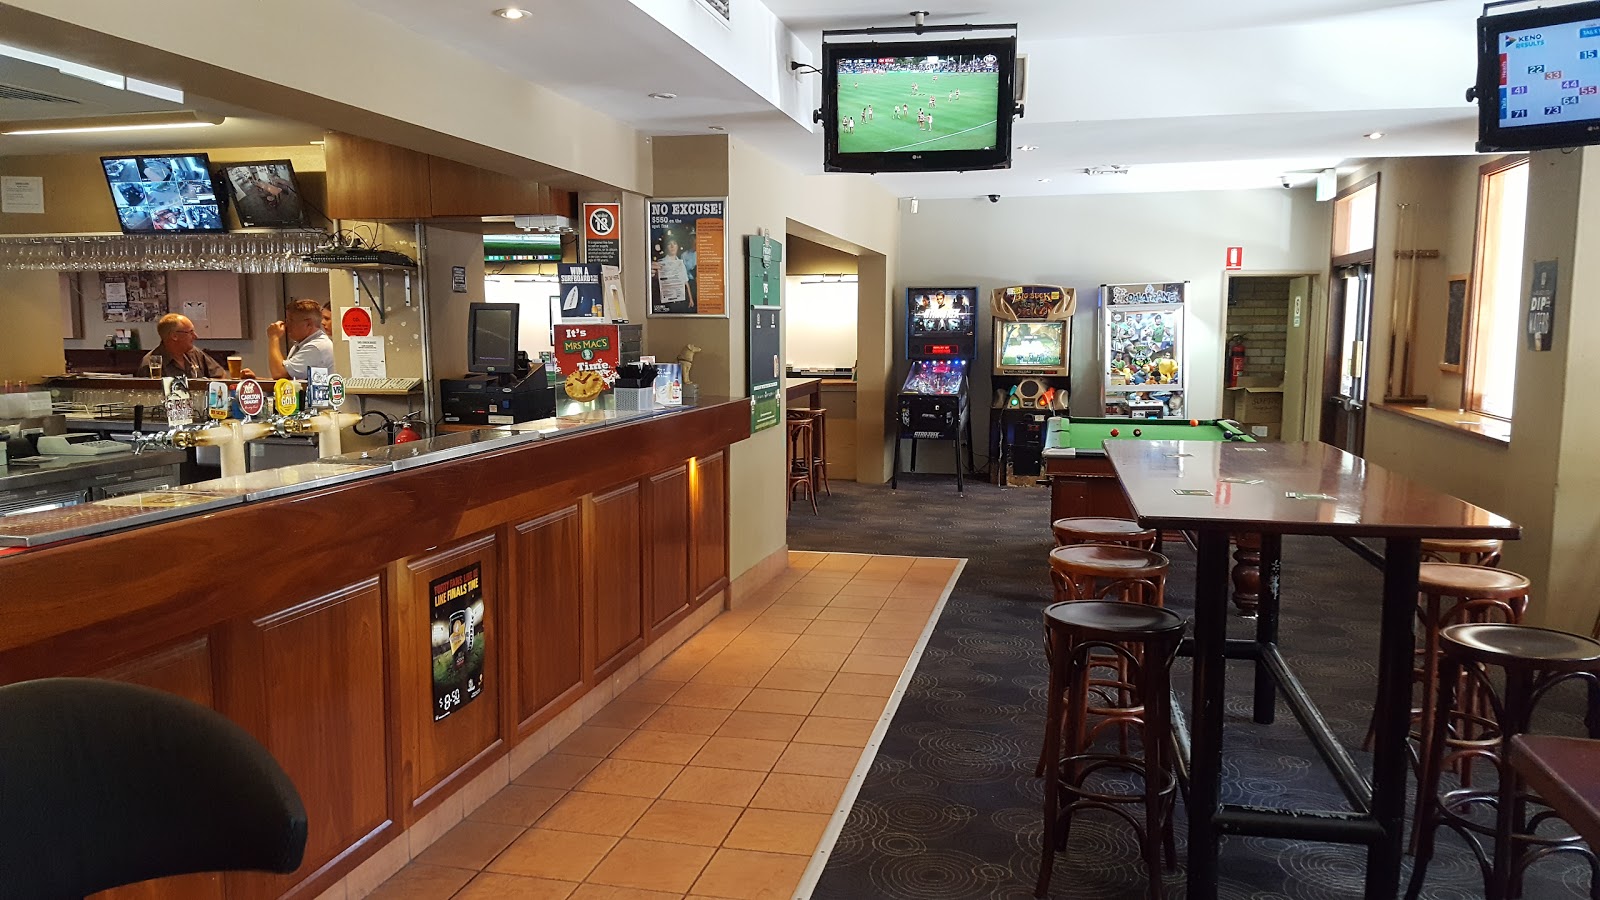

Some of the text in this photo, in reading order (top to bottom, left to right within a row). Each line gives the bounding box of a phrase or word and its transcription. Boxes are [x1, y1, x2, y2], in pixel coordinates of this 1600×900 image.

[1518, 33, 1542, 42] KENO
[1515, 39, 1545, 49] RESULTS
[1583, 50, 1595, 59] 15
[1529, 65, 1543, 74] 22
[1545, 71, 1560, 80] 33
[1562, 81, 1577, 89] 44
[1514, 87, 1525, 95] 41
[1581, 86, 1595, 95] 55
[1562, 97, 1577, 105] 64
[1514, 109, 1525, 118] 71
[1546, 106, 1560, 115] 73
[651, 203, 722, 215] NO EXCUSE!
[595, 218, 607, 231] 18
[651, 216, 669, 224] $550
[569, 266, 589, 275] WIN A
[560, 274, 591, 282] SURFBOARD
[1530, 297, 1547, 311] DIP
[565, 328, 587, 338] It's
[565, 338, 608, 351] MRS MAC'S
[576, 361, 609, 371] Time
[240, 393, 261, 401] CARLTON
[281, 396, 297, 406] GOLD
[434, 592, 447, 608] LIKE
[447, 583, 467, 602] FINALS
